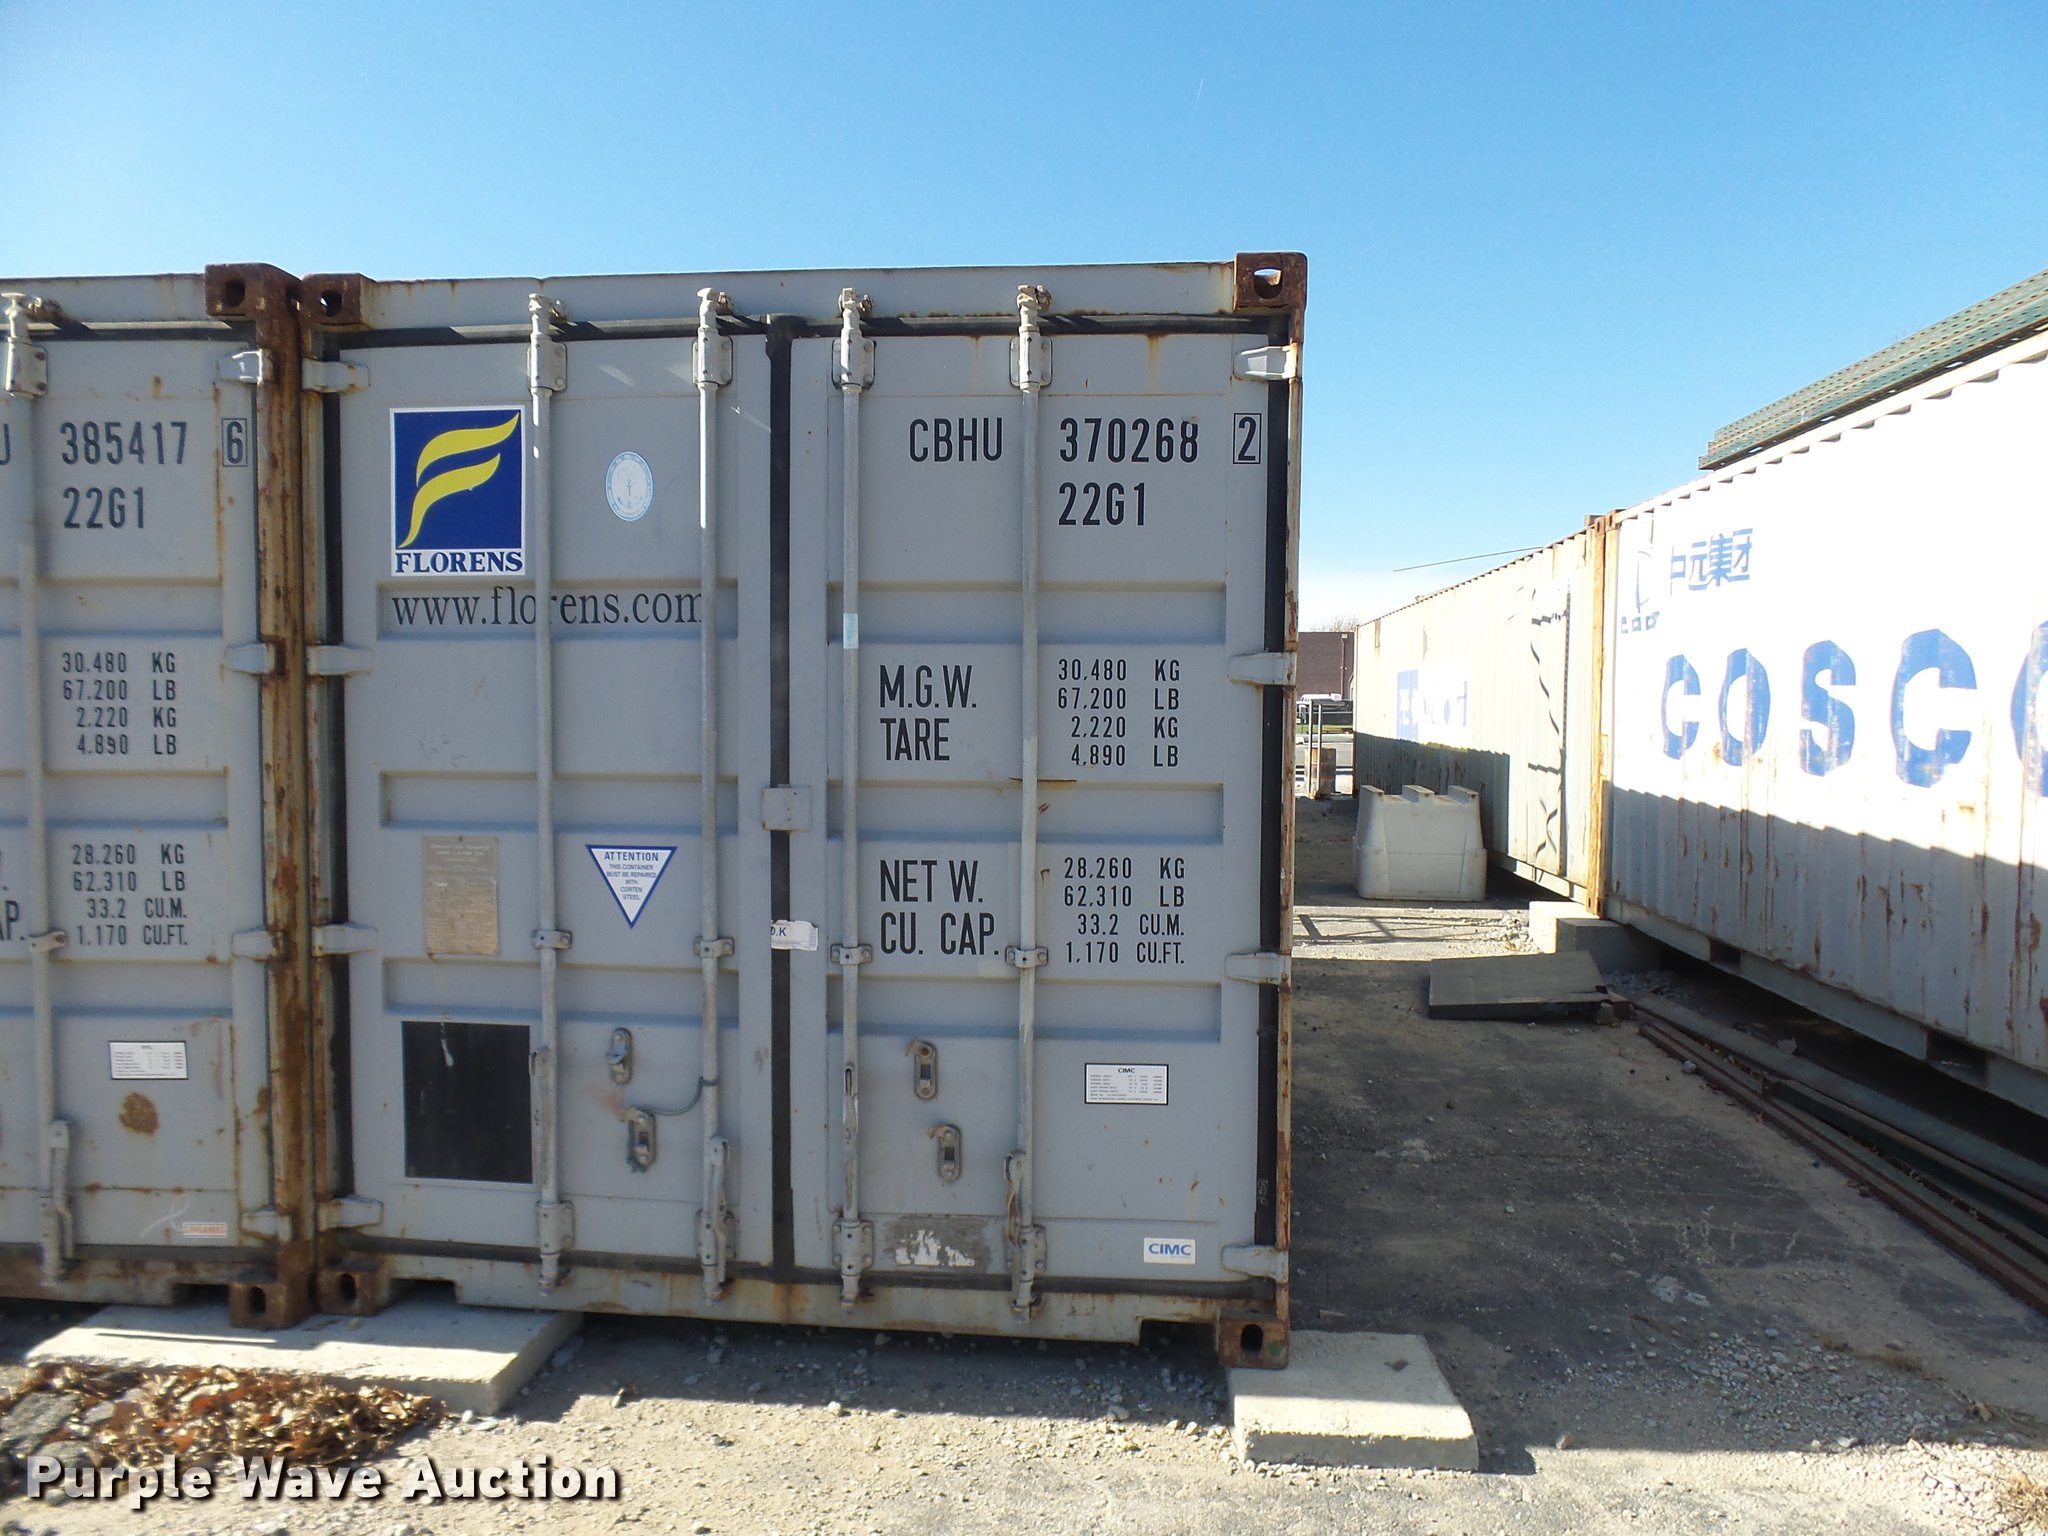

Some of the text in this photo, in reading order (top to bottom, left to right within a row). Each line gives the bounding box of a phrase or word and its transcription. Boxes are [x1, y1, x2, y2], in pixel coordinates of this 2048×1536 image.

[60, 421, 187, 465] 385417
[226, 420, 244, 464] 6
[909, 416, 1257, 463] CBHU 370268 2
[62, 486, 145, 529] 22G1
[1058, 482, 1146, 526] 22G1
[395, 551, 523, 573] FLORENS
[152, 652, 176, 673] KG
[1058, 658, 1180, 682] 30,480 KG
[152, 679, 176, 701] LB
[879, 664, 977, 708] M.G.W.
[1057, 687, 1179, 710] 67,200 LB
[153, 706, 177, 728] KG
[1071, 715, 1179, 738] 2,220 KG
[153, 733, 177, 755] LB
[879, 717, 951, 761] TARE
[1070, 744, 1179, 767] 4,890 LB
[160, 843, 185, 865] KG
[603, 851, 659, 862] ATTENTION
[1064, 857, 1185, 879] 28,260 KG
[161, 870, 186, 892] LB
[880, 859, 984, 903] NET W.
[1064, 885, 1185, 907] 62,310 LB
[87, 897, 187, 919] 33.2 CU.M.
[880, 911, 999, 956] CU. CAP.
[1077, 913, 1185, 936] 33.2 CU.M.
[1066, 941, 1185, 964] 1,170 CU.FT.
[1148, 1243, 1192, 1256] CIMC
